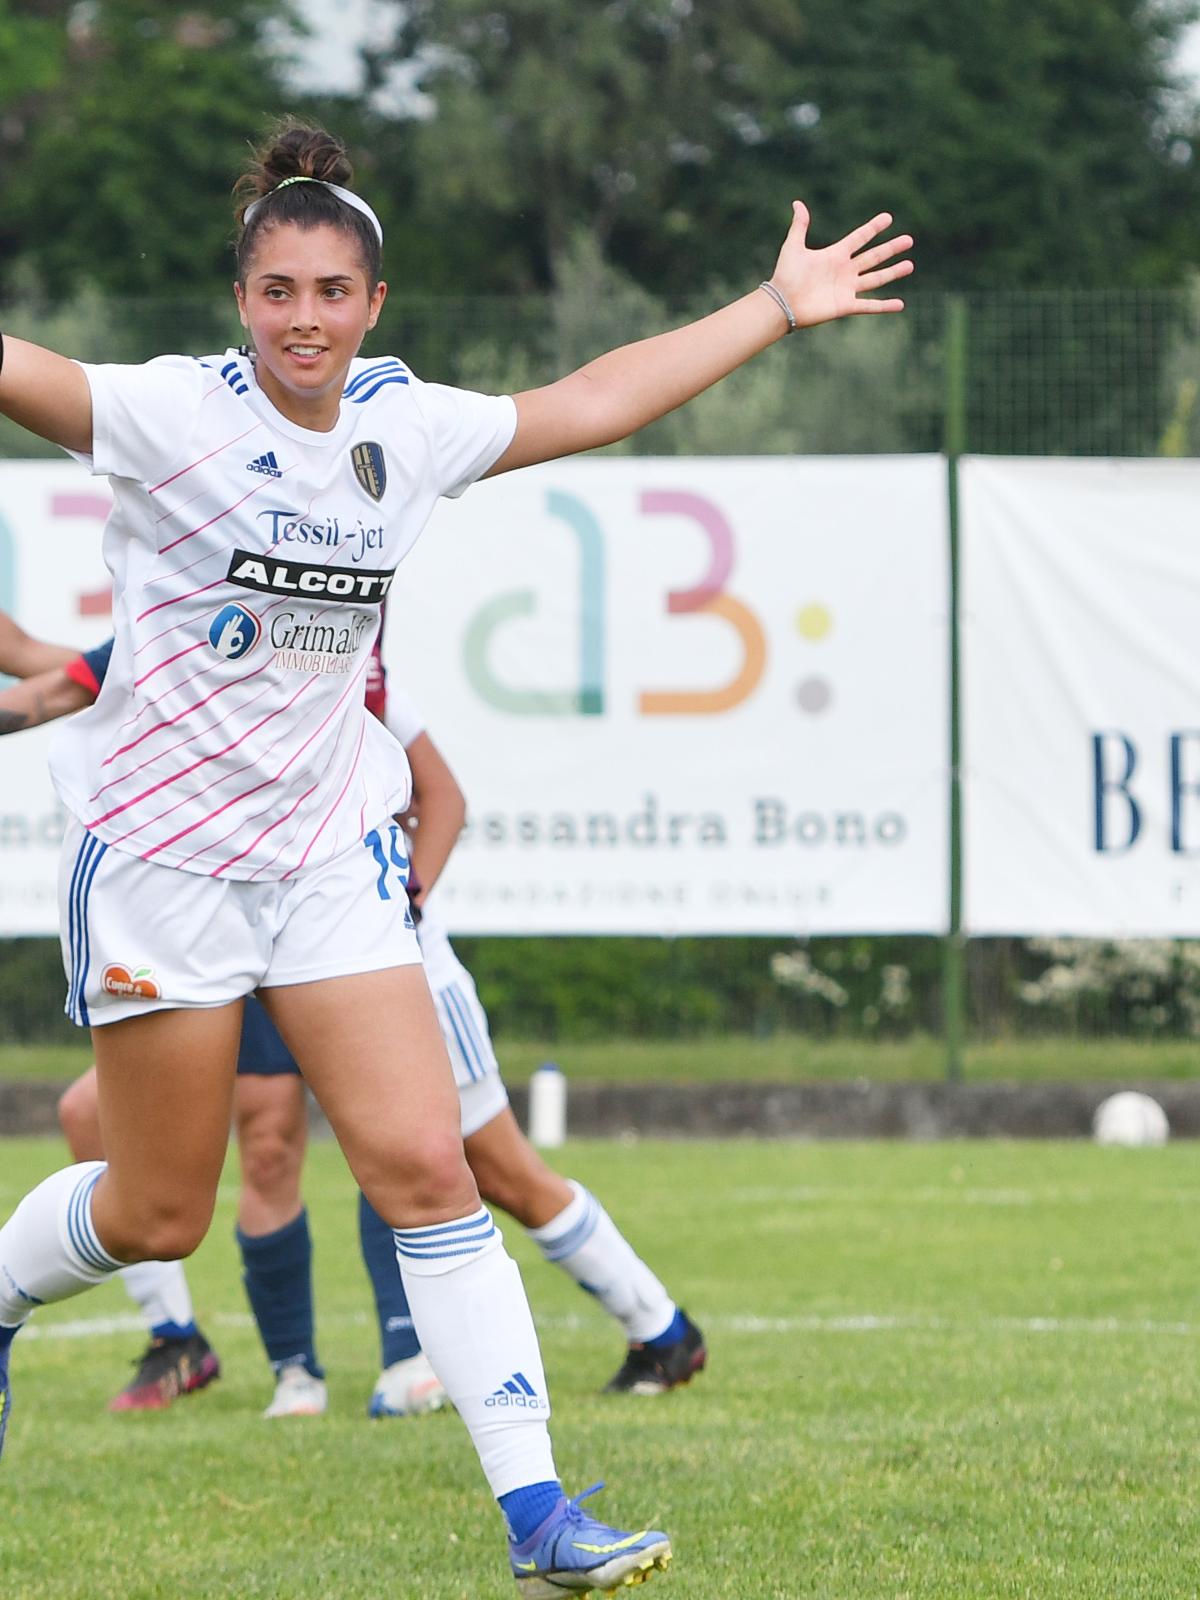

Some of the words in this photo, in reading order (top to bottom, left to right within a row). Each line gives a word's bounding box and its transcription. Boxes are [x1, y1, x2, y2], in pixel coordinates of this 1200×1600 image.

[246, 462, 283, 478] adidas
[231, 559, 393, 597] ALCOTT
[751, 796, 909, 849] Bono
[484, 1393, 547, 1409] adidas
